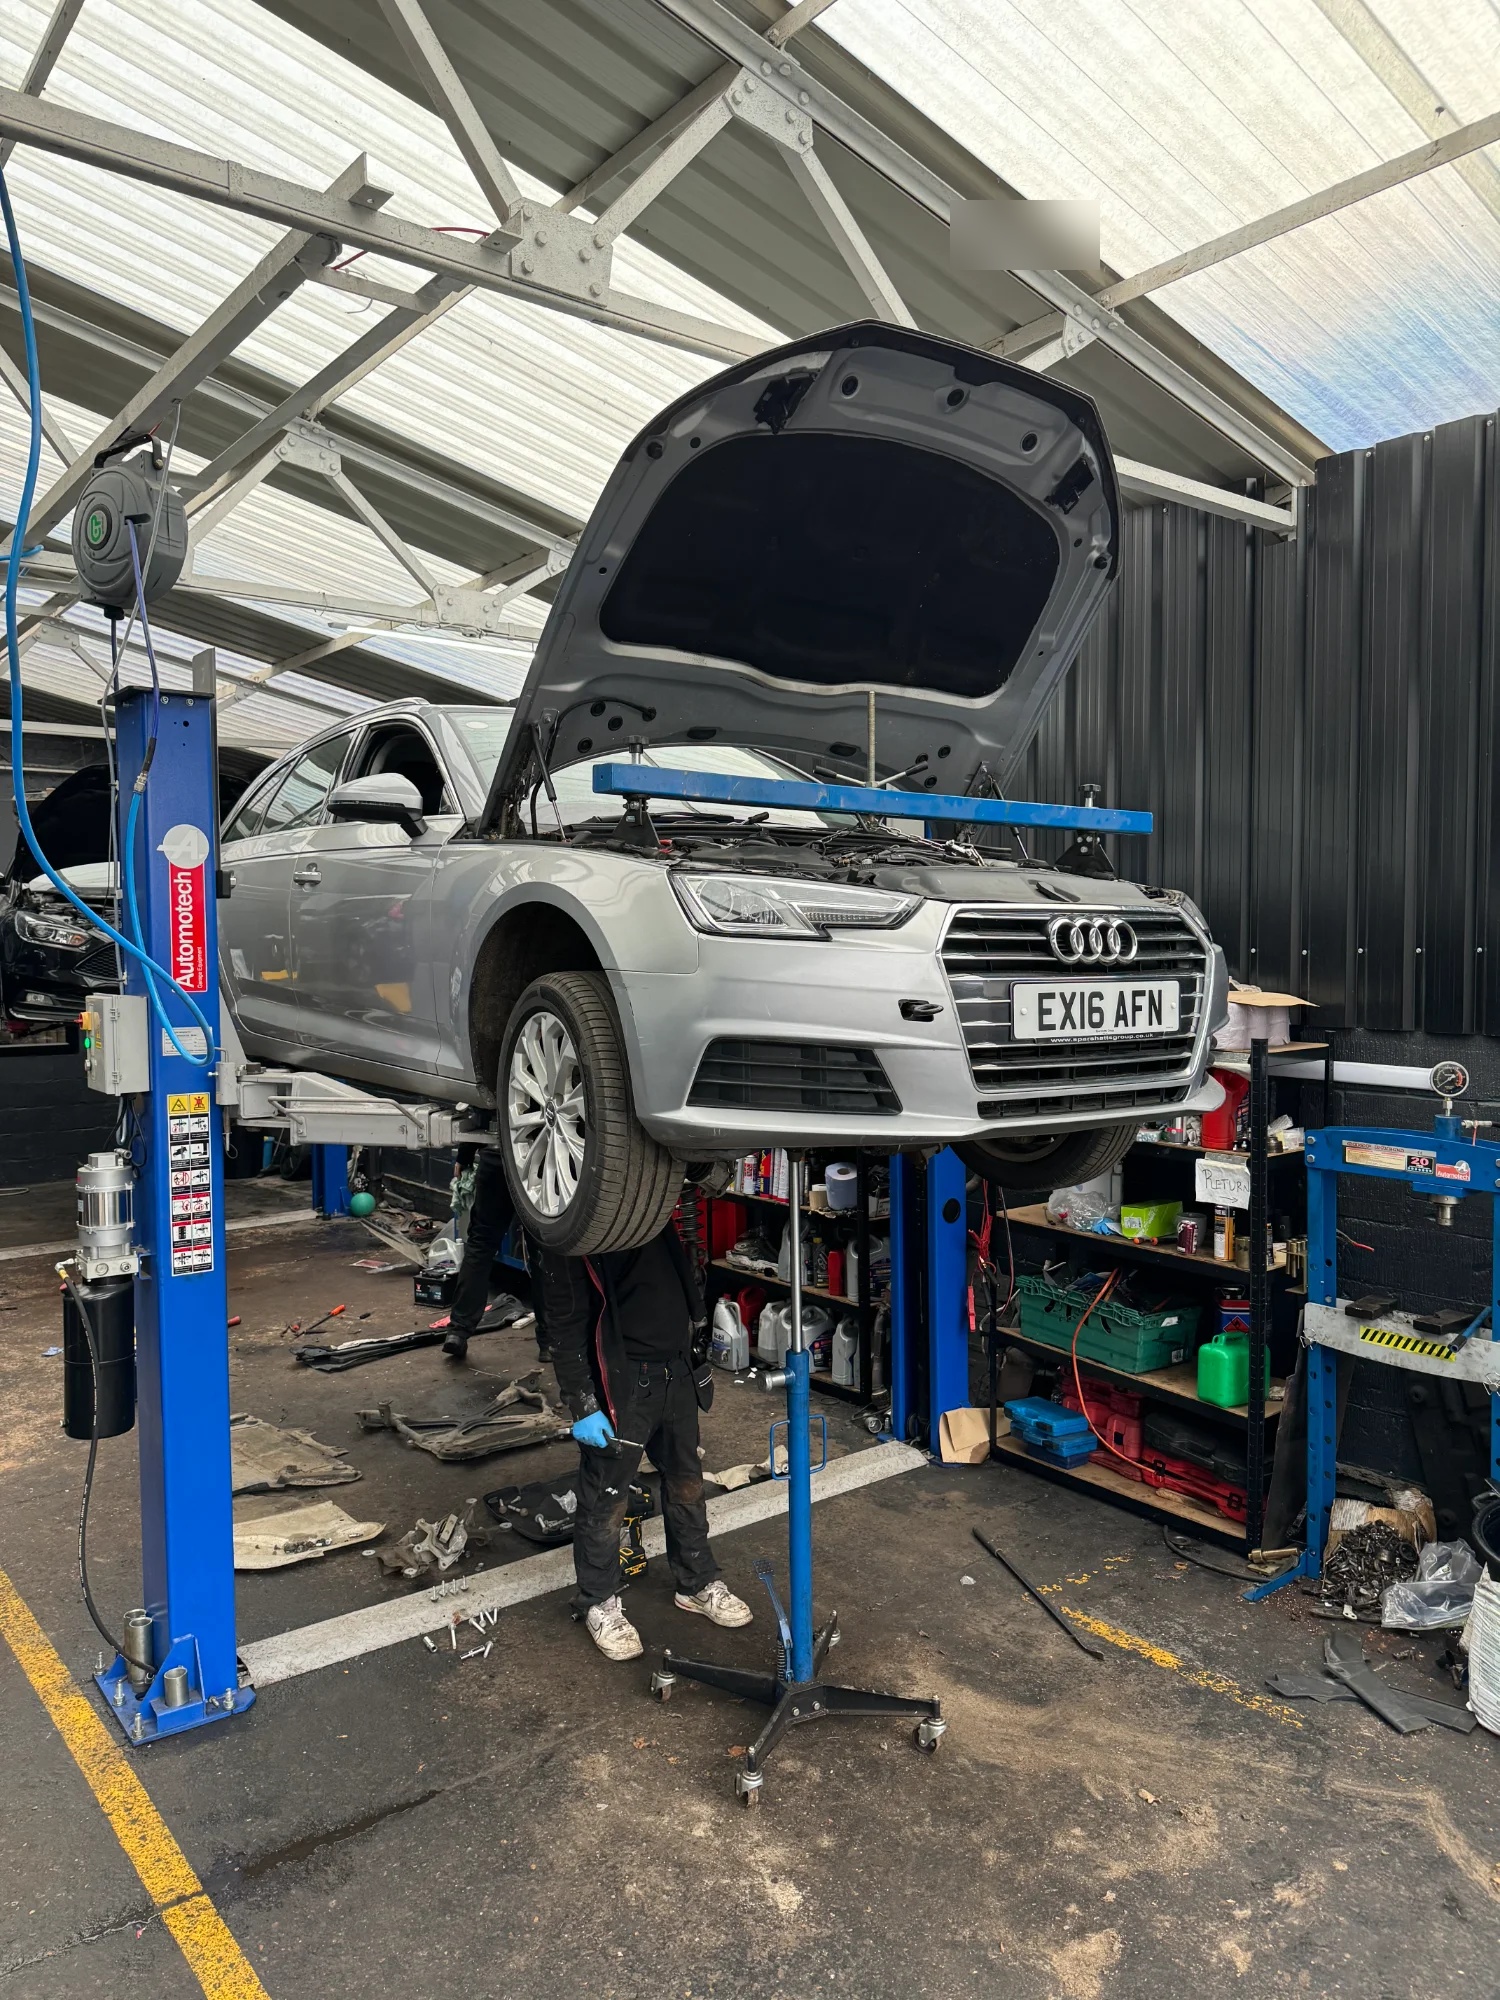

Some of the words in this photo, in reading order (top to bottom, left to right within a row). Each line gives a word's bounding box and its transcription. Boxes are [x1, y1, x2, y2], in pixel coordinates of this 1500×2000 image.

[174, 871, 195, 988] Automotech
[1038, 991, 1105, 1031] EX16
[1114, 989, 1163, 1028] AFN
[1410, 1156, 1429, 1167] 20
[1202, 1168, 1250, 1193] RETURN
[1437, 1170, 1470, 1181] Automotech
